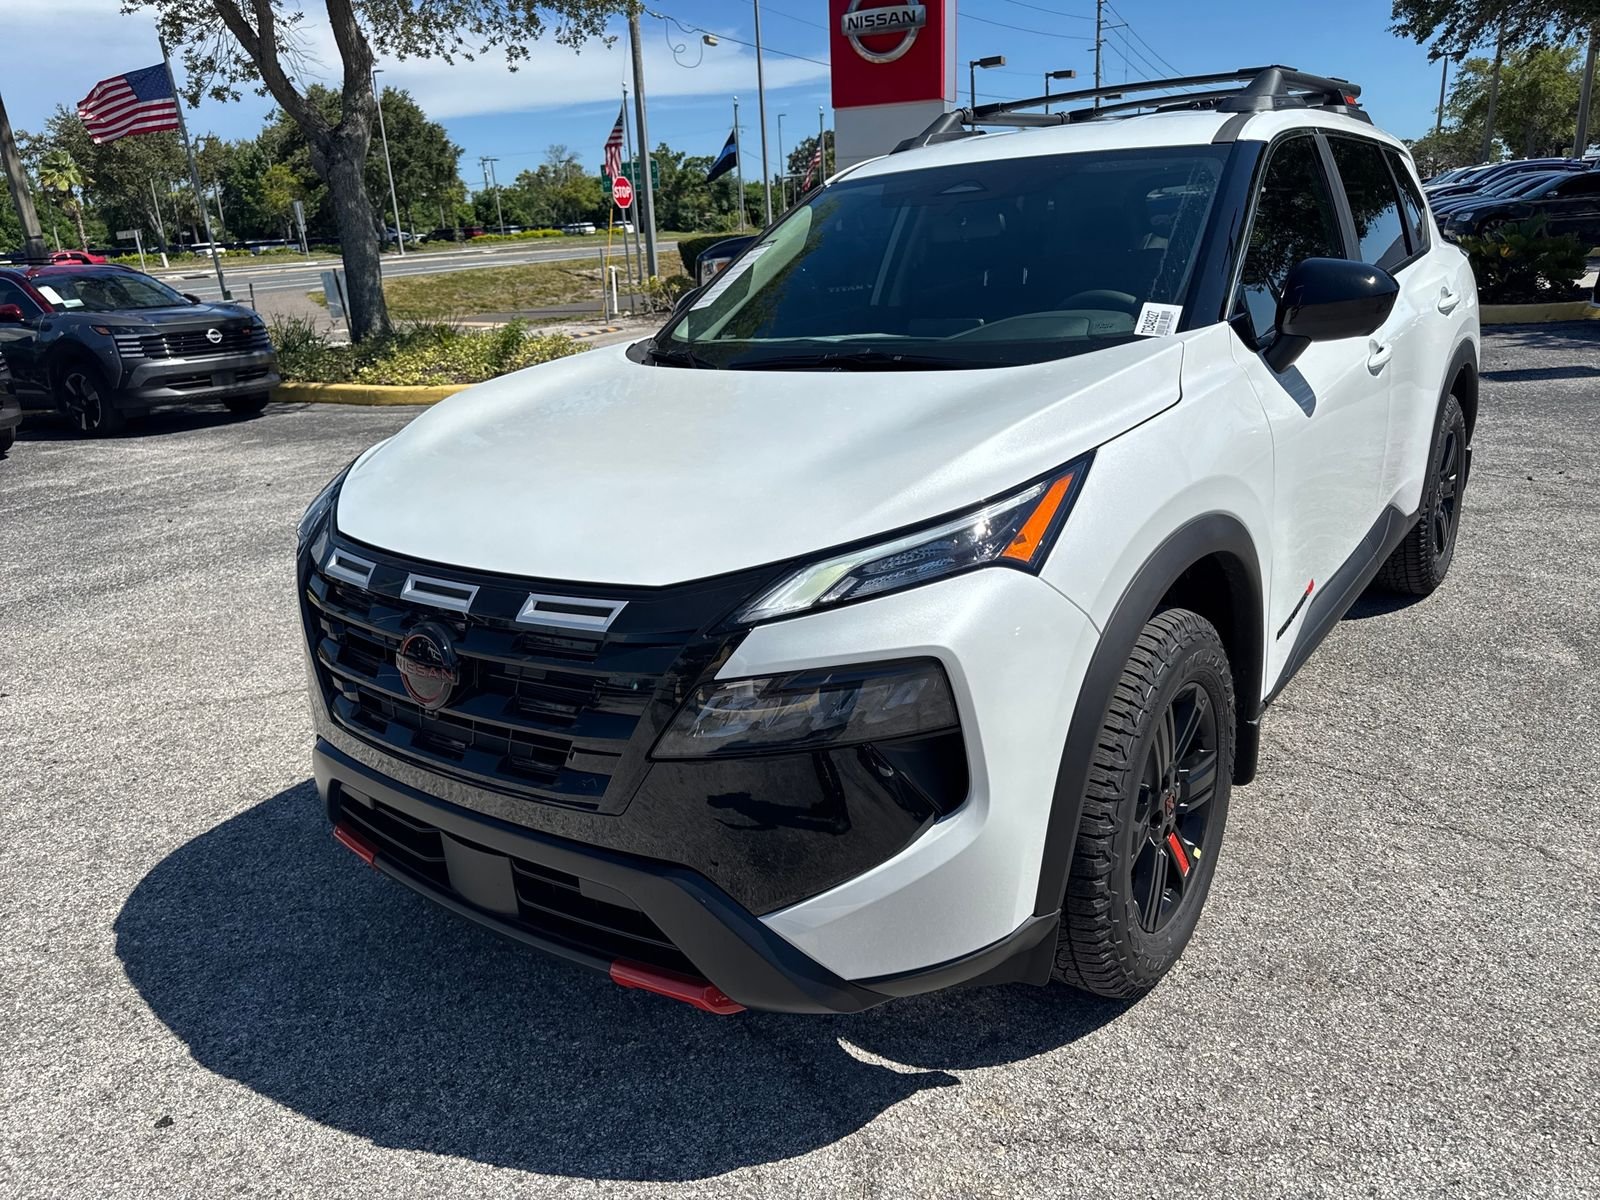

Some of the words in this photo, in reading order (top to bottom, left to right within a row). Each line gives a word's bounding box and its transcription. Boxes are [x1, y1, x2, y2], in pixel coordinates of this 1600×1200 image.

[848, 10, 916, 30] NISSAN
[614, 186, 631, 198] STOP
[396, 656, 454, 681] NISSAN
